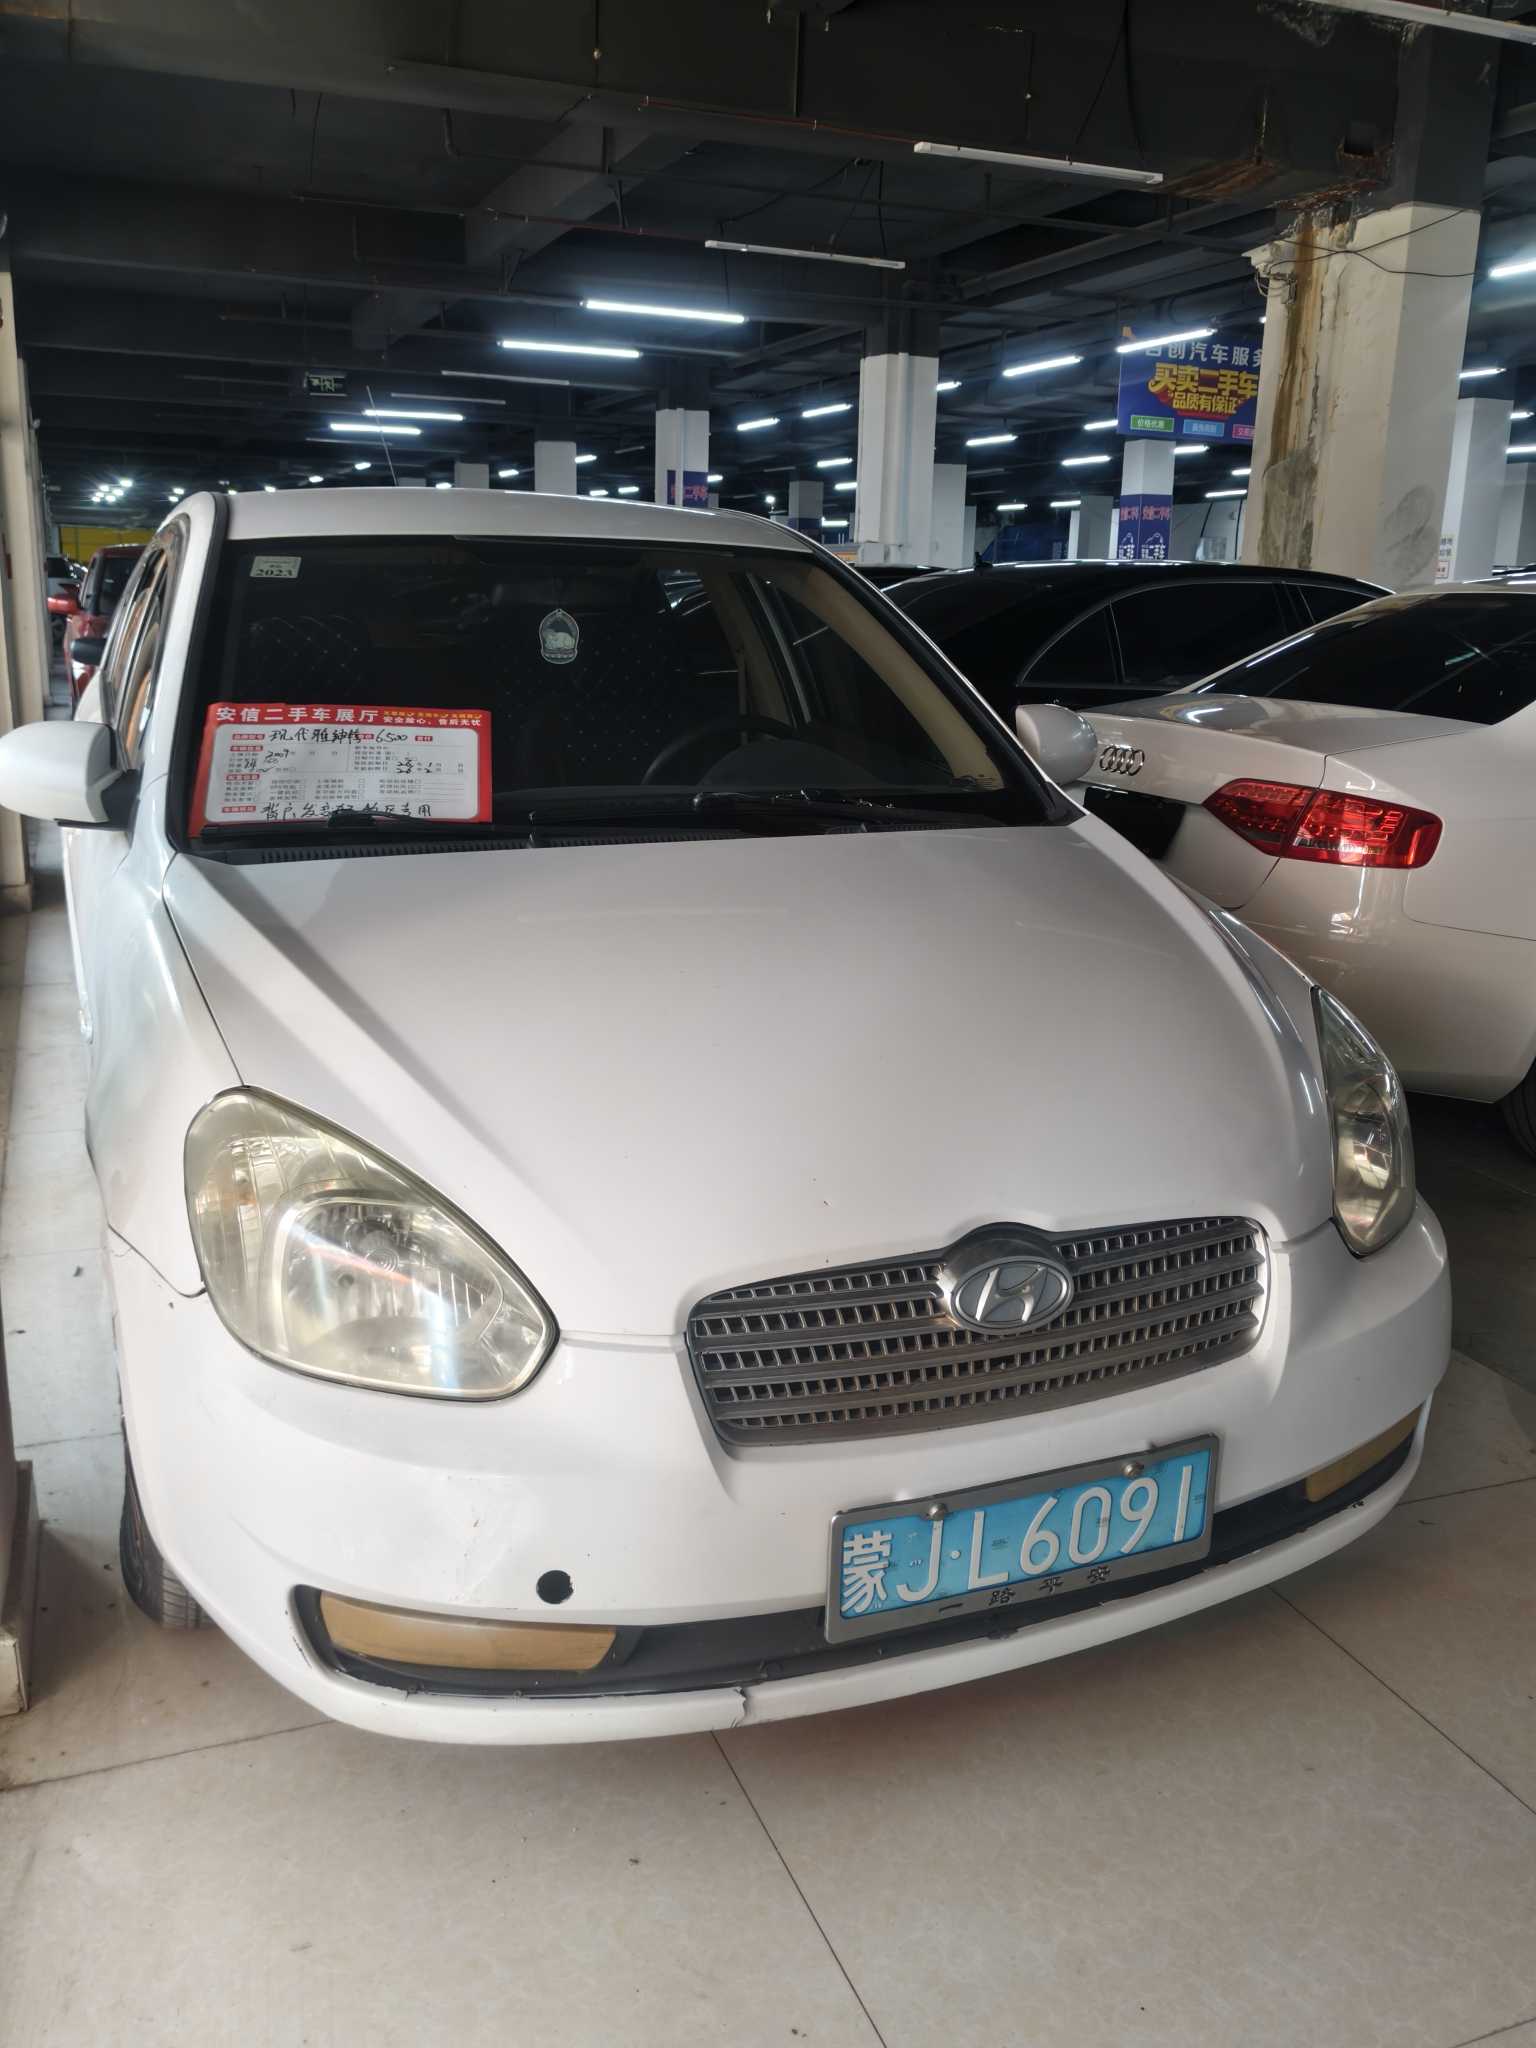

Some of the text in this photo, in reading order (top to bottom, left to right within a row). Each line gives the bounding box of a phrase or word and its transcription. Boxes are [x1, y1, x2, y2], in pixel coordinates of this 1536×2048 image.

[1148, 362, 1258, 397] 买卖二手车
[216, 707, 378, 722] 安信二手车展厅
